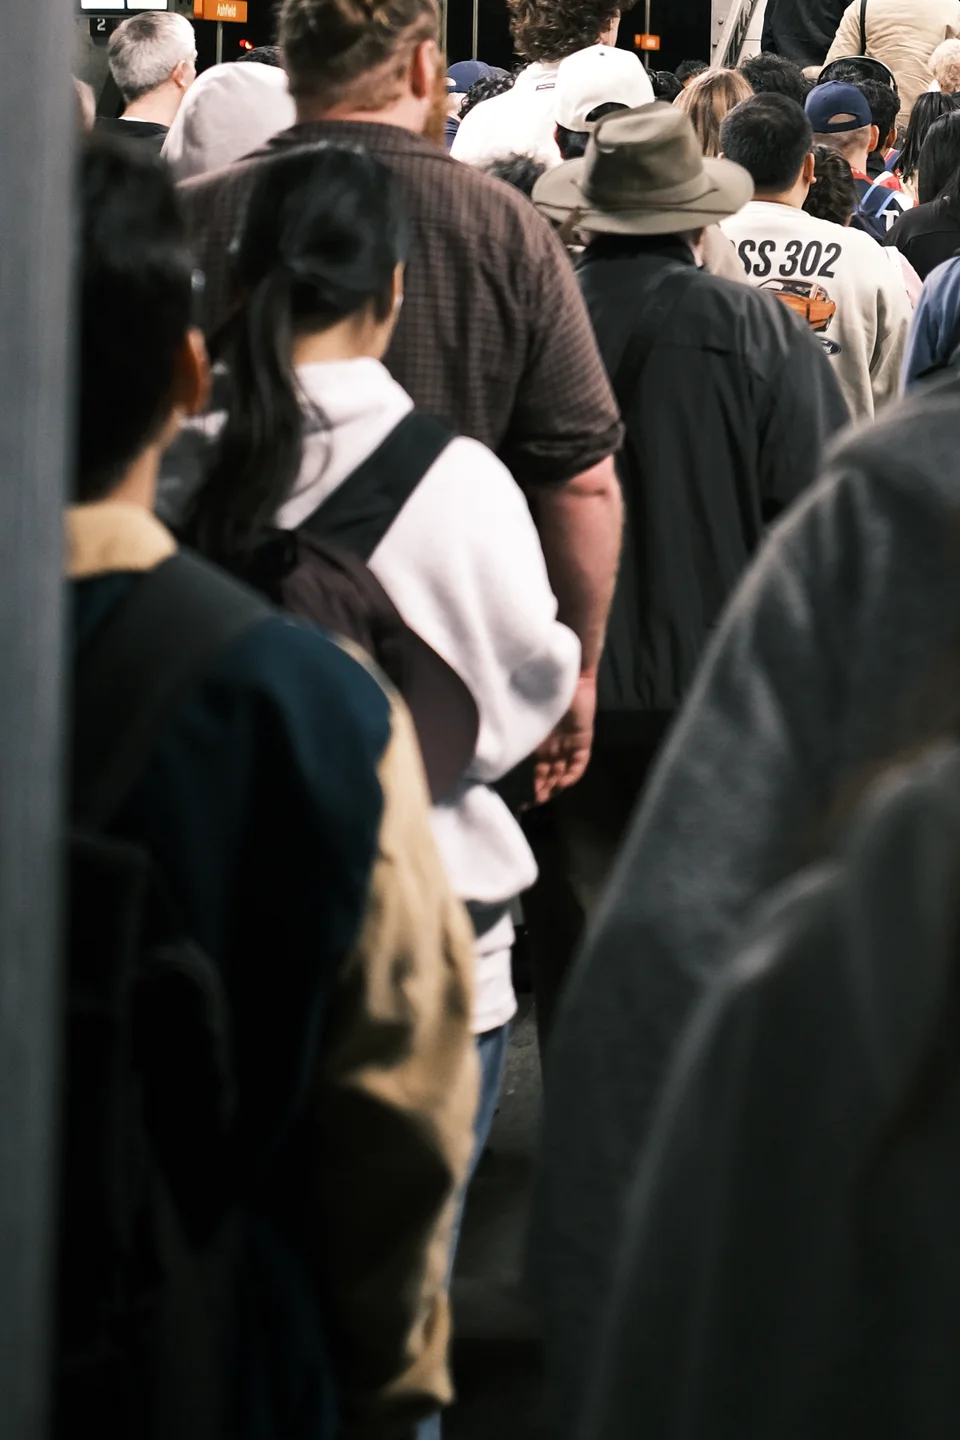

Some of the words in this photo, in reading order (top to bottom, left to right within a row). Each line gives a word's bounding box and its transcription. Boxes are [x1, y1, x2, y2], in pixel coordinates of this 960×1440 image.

[216, 3, 237, 18] Ashfield
[97, 18, 106, 31] 2
[779, 240, 842, 278] 302
